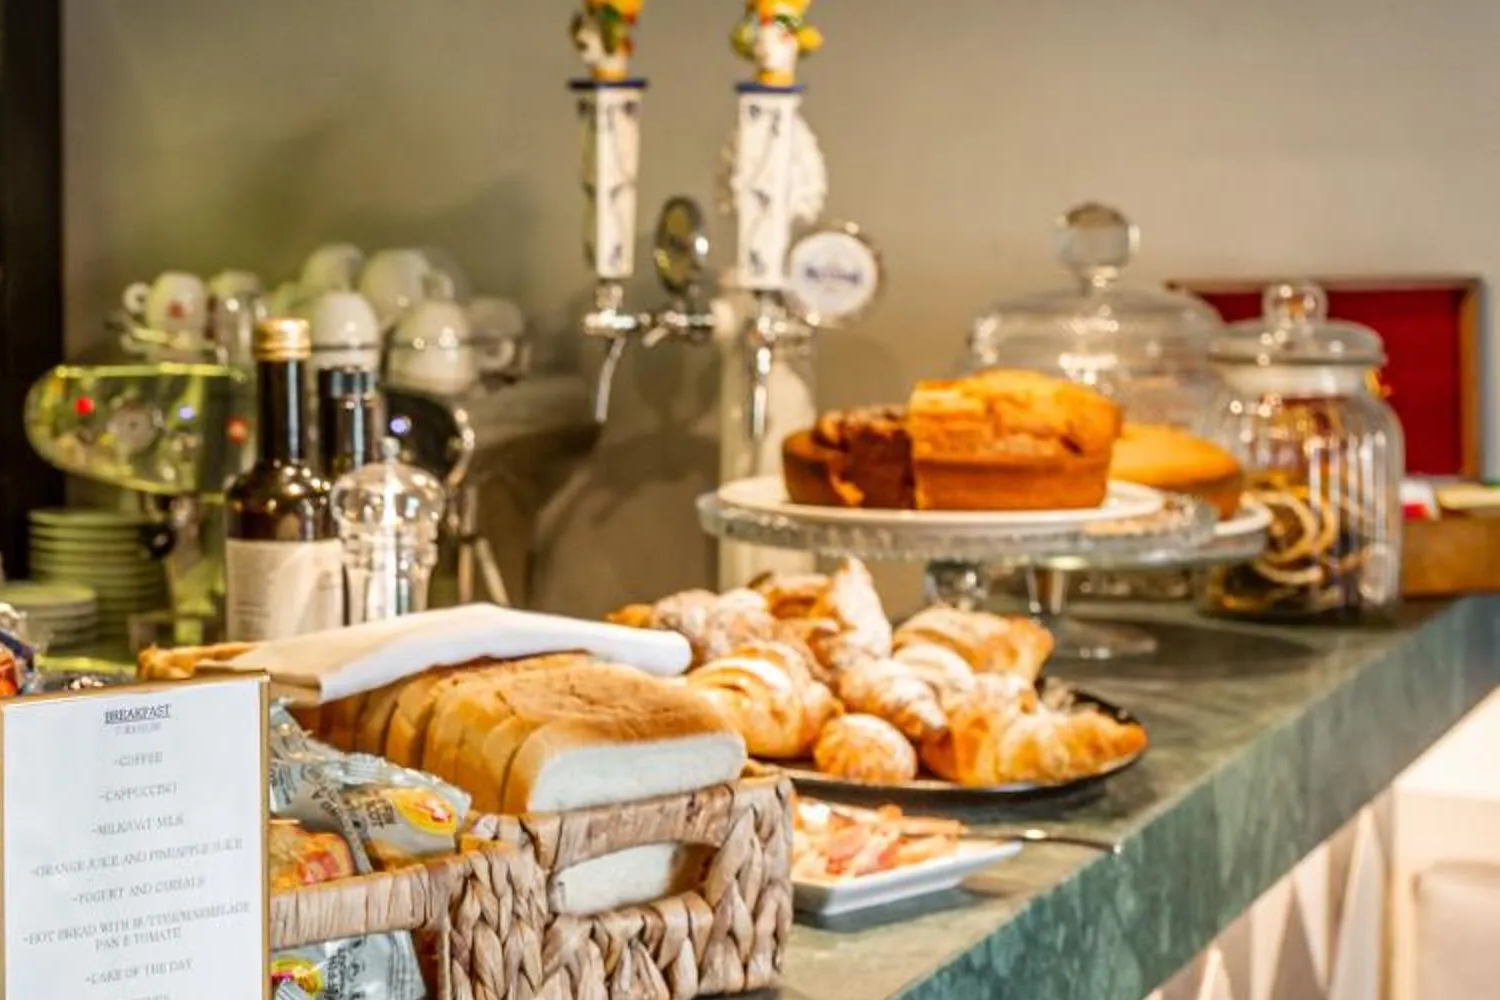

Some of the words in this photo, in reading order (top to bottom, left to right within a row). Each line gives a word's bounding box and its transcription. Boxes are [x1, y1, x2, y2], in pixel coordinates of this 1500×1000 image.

[105, 704, 171, 724] BREAKFAST
[122, 852, 146, 866] AND
[129, 884, 153, 898] AND
[57, 926, 97, 942] BREAD
[99, 920, 130, 937] WITH
[95, 937, 119, 951] PAN
[124, 965, 139, 979] OF
[145, 961, 167, 977] THE
[169, 957, 193, 973] DAY
